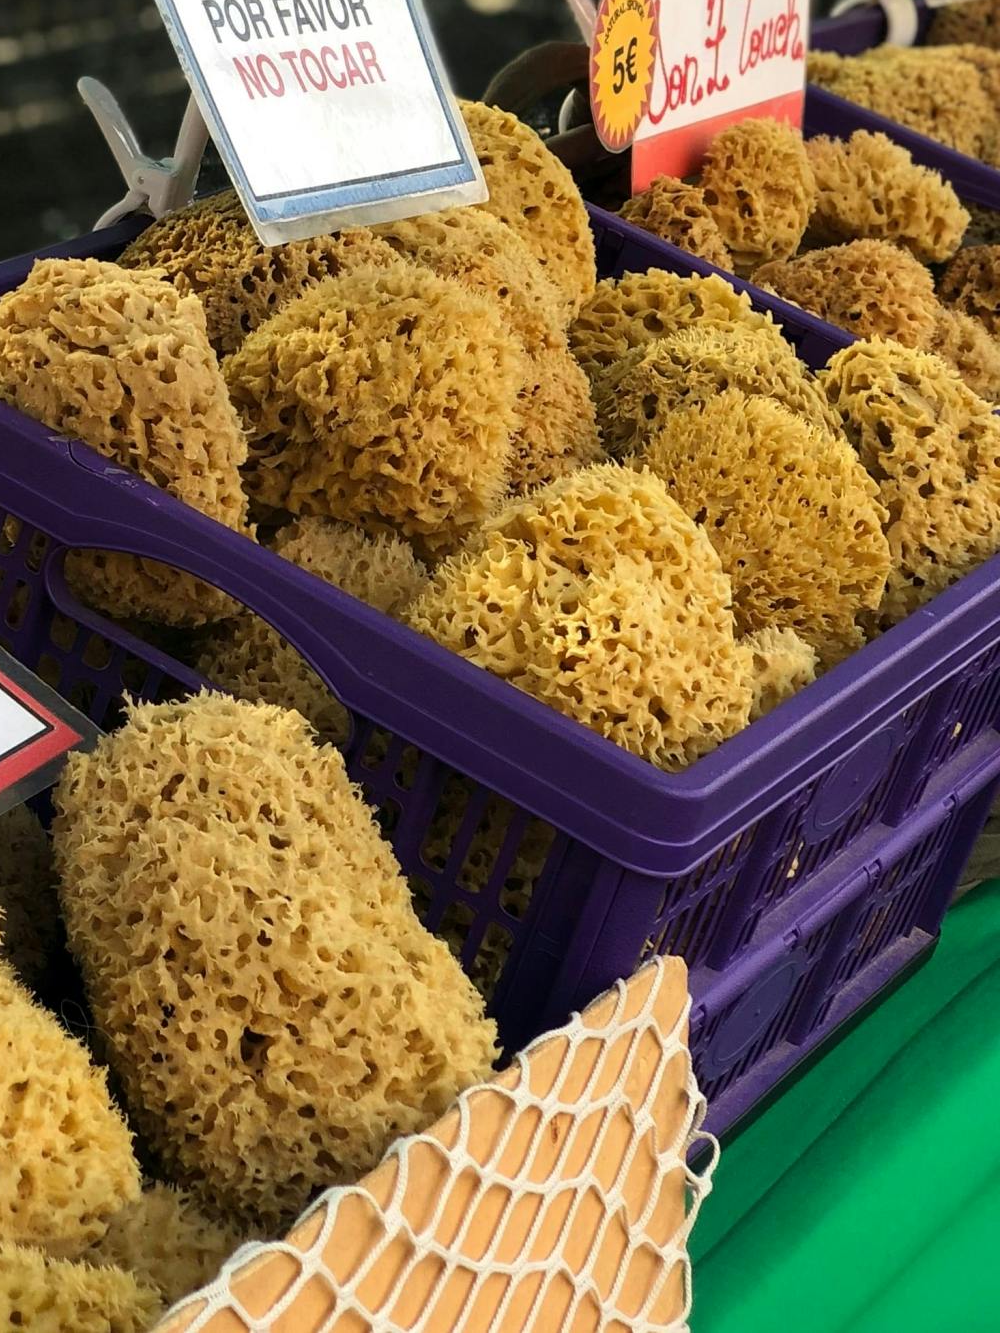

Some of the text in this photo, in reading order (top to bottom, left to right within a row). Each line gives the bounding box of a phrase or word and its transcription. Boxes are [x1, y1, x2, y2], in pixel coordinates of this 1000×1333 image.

[232, 41, 387, 100] NO TOCAR
[612, 37, 638, 95] 5€
